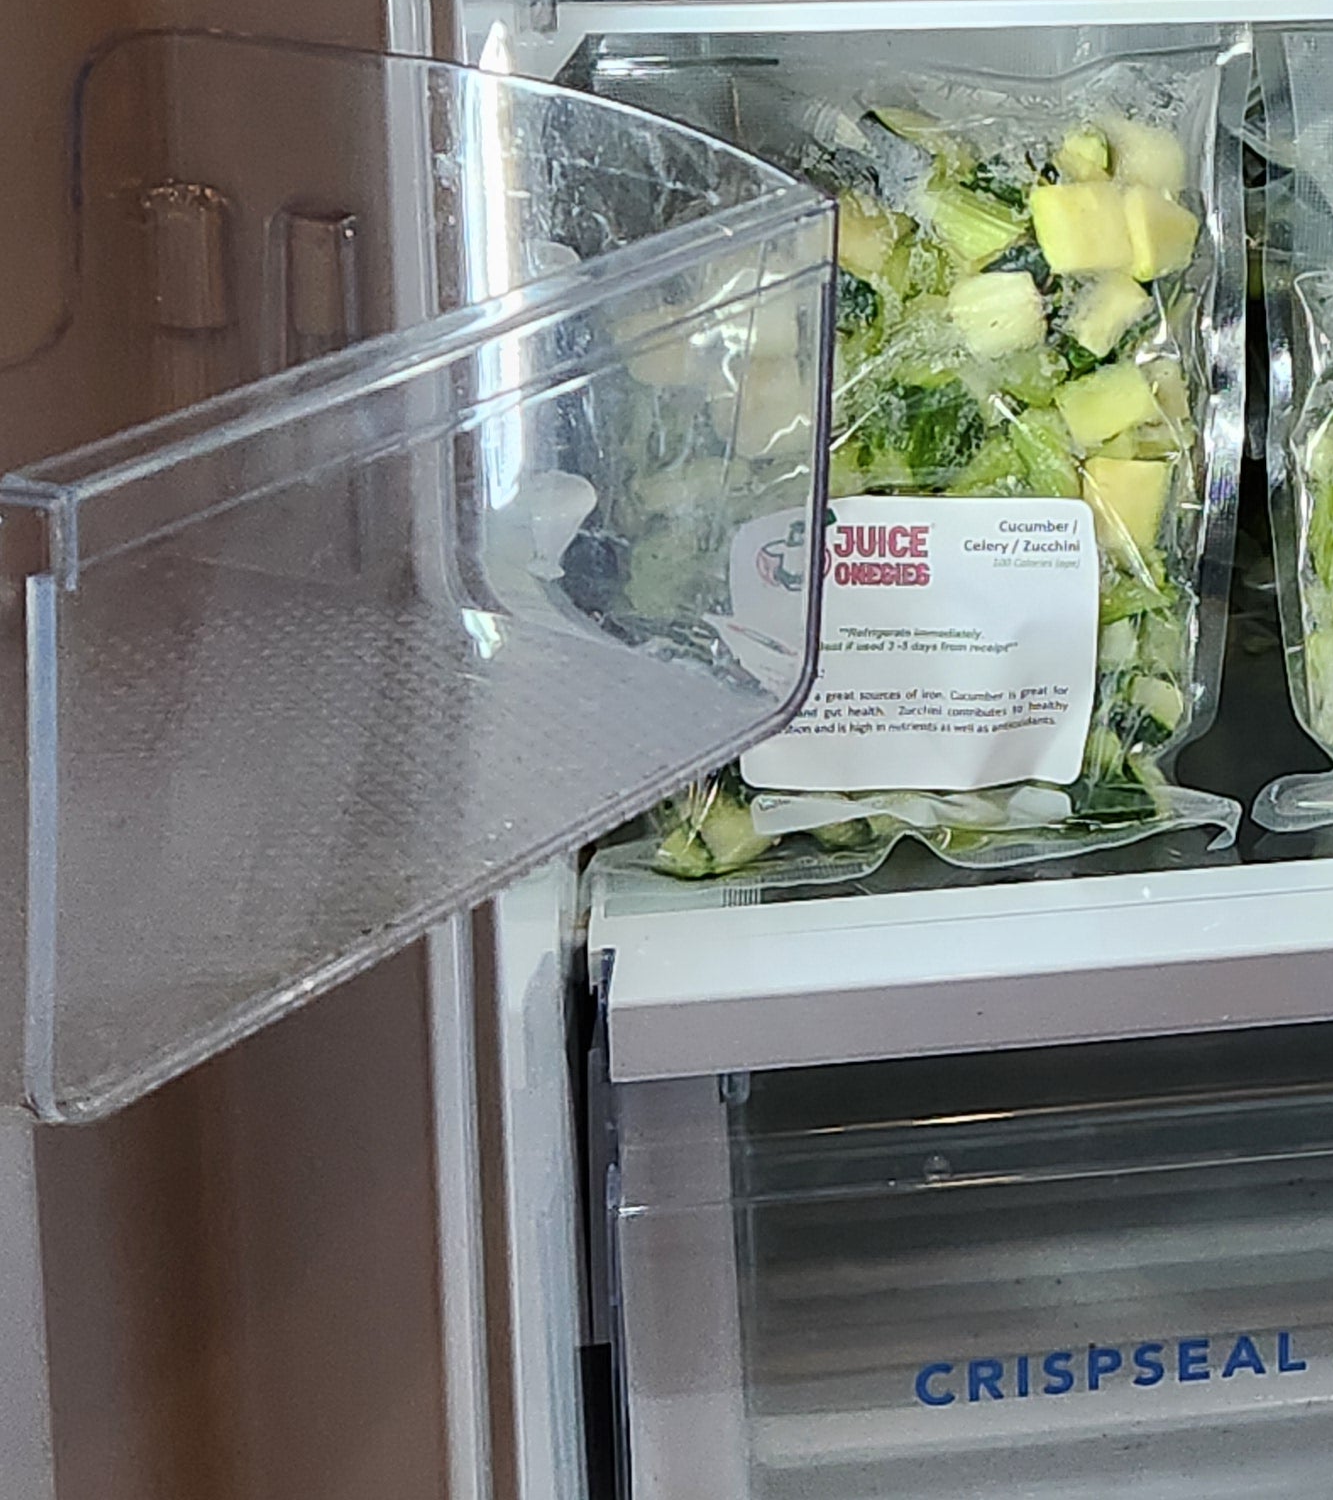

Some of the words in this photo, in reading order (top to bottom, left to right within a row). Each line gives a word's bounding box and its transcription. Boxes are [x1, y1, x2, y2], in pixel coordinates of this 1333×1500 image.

[999, 520, 1069, 532] Cucumber
[833, 526, 931, 558] JUICE
[964, 540, 1008, 554] Celery
[1023, 540, 1081, 552] Zucchini
[834, 562, 931, 586] ONESIES
[821, 641, 843, 651] est
[856, 641, 884, 651] used
[911, 642, 937, 653] days
[940, 642, 967, 651] from
[826, 691, 855, 703] great
[860, 691, 901, 701] sources
[905, 689, 917, 700] of
[950, 690, 1003, 701] Cucumber
[1020, 687, 1047, 699] great
[1053, 685, 1068, 695] for
[824, 709, 842, 720] gut
[898, 706, 942, 716] Zucchini
[947, 707, 1006, 717] contributes
[1012, 705, 1023, 714] to
[1029, 700, 1068, 713] healthy
[815, 723, 835, 733] and
[838, 722, 846, 733] is
[850, 722, 873, 734] high
[888, 721, 937, 731] nutrients
[954, 722, 974, 732] well
[914, 1332, 1307, 1408] CRISPSEAL
